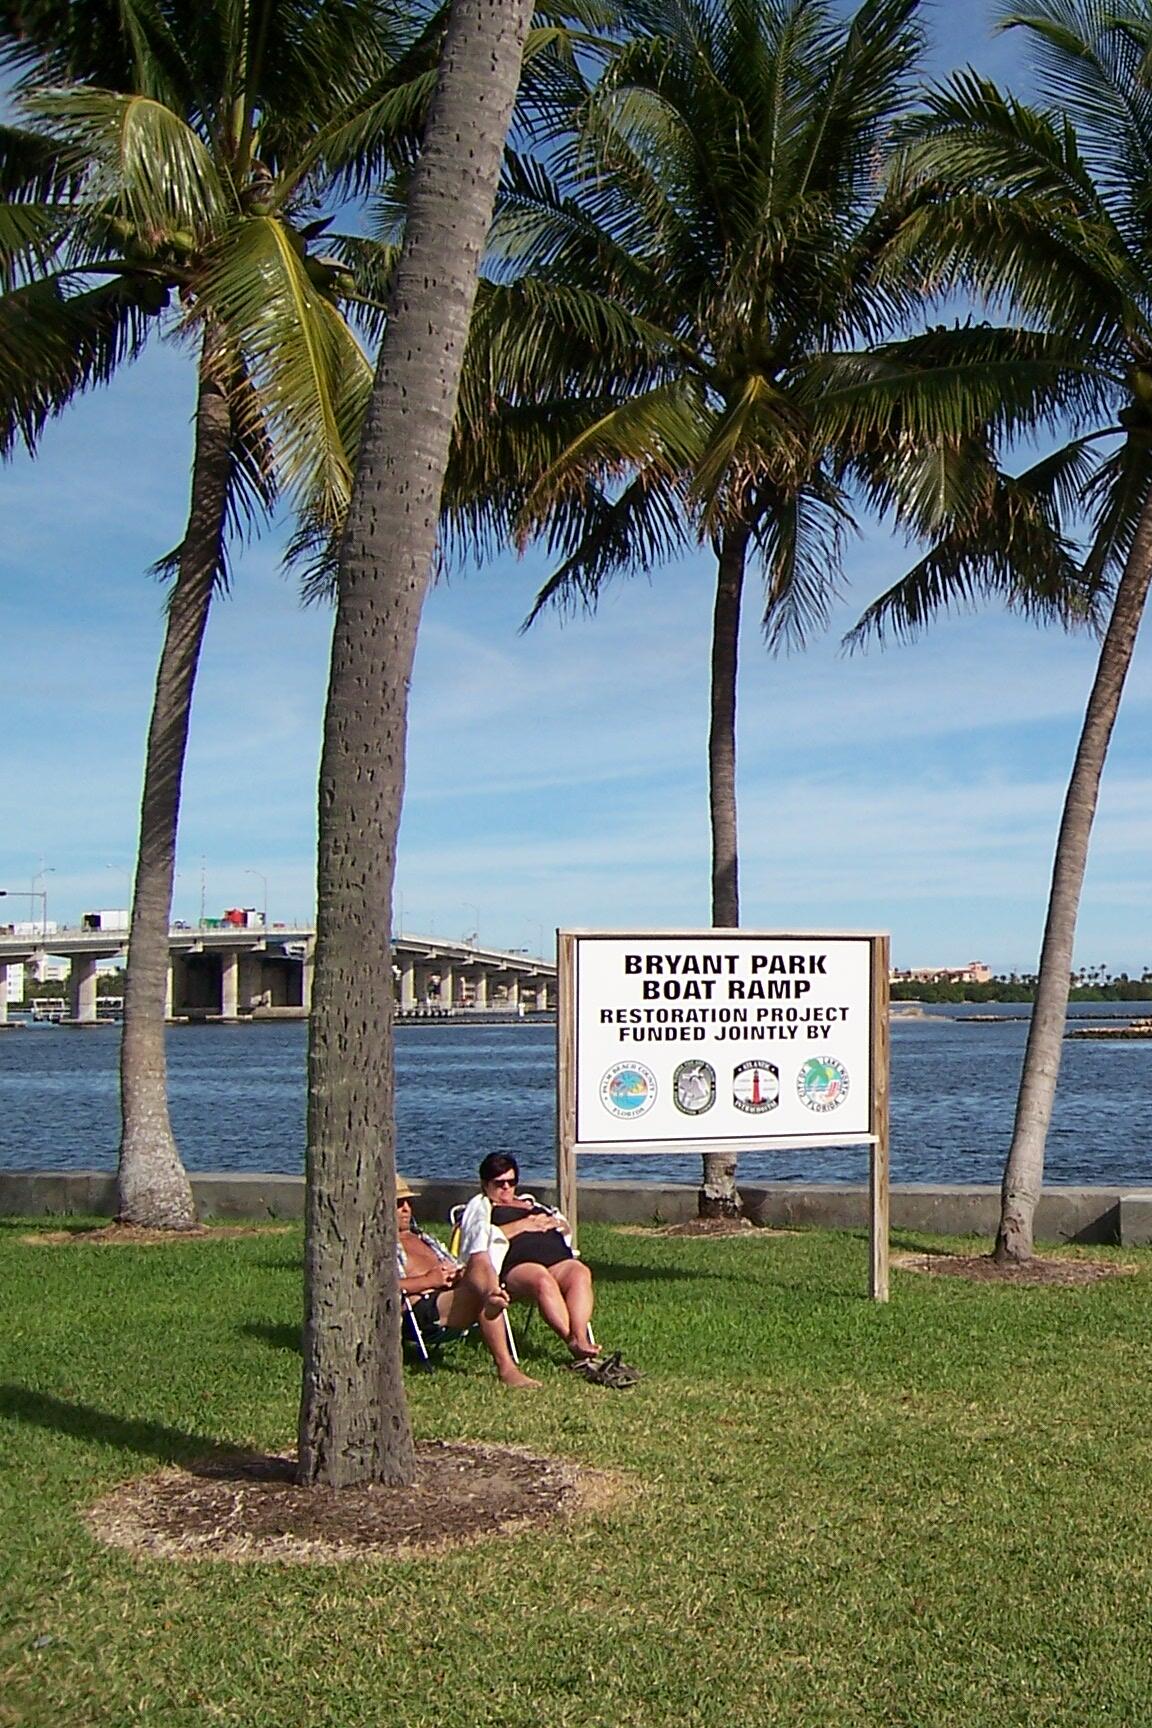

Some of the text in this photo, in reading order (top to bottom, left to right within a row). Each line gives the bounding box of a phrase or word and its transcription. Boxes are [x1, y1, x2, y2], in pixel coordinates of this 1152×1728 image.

[624, 954, 827, 975] BRYANT PARK
[642, 979, 811, 1000] BOAT RAMP
[600, 1006, 850, 1024] RESTORATION PROJECT
[619, 1025, 831, 1042] FUNDED JOINTLY BY
[821, 1056, 841, 1070] LAKE
[838, 1069, 849, 1096] WORTH
